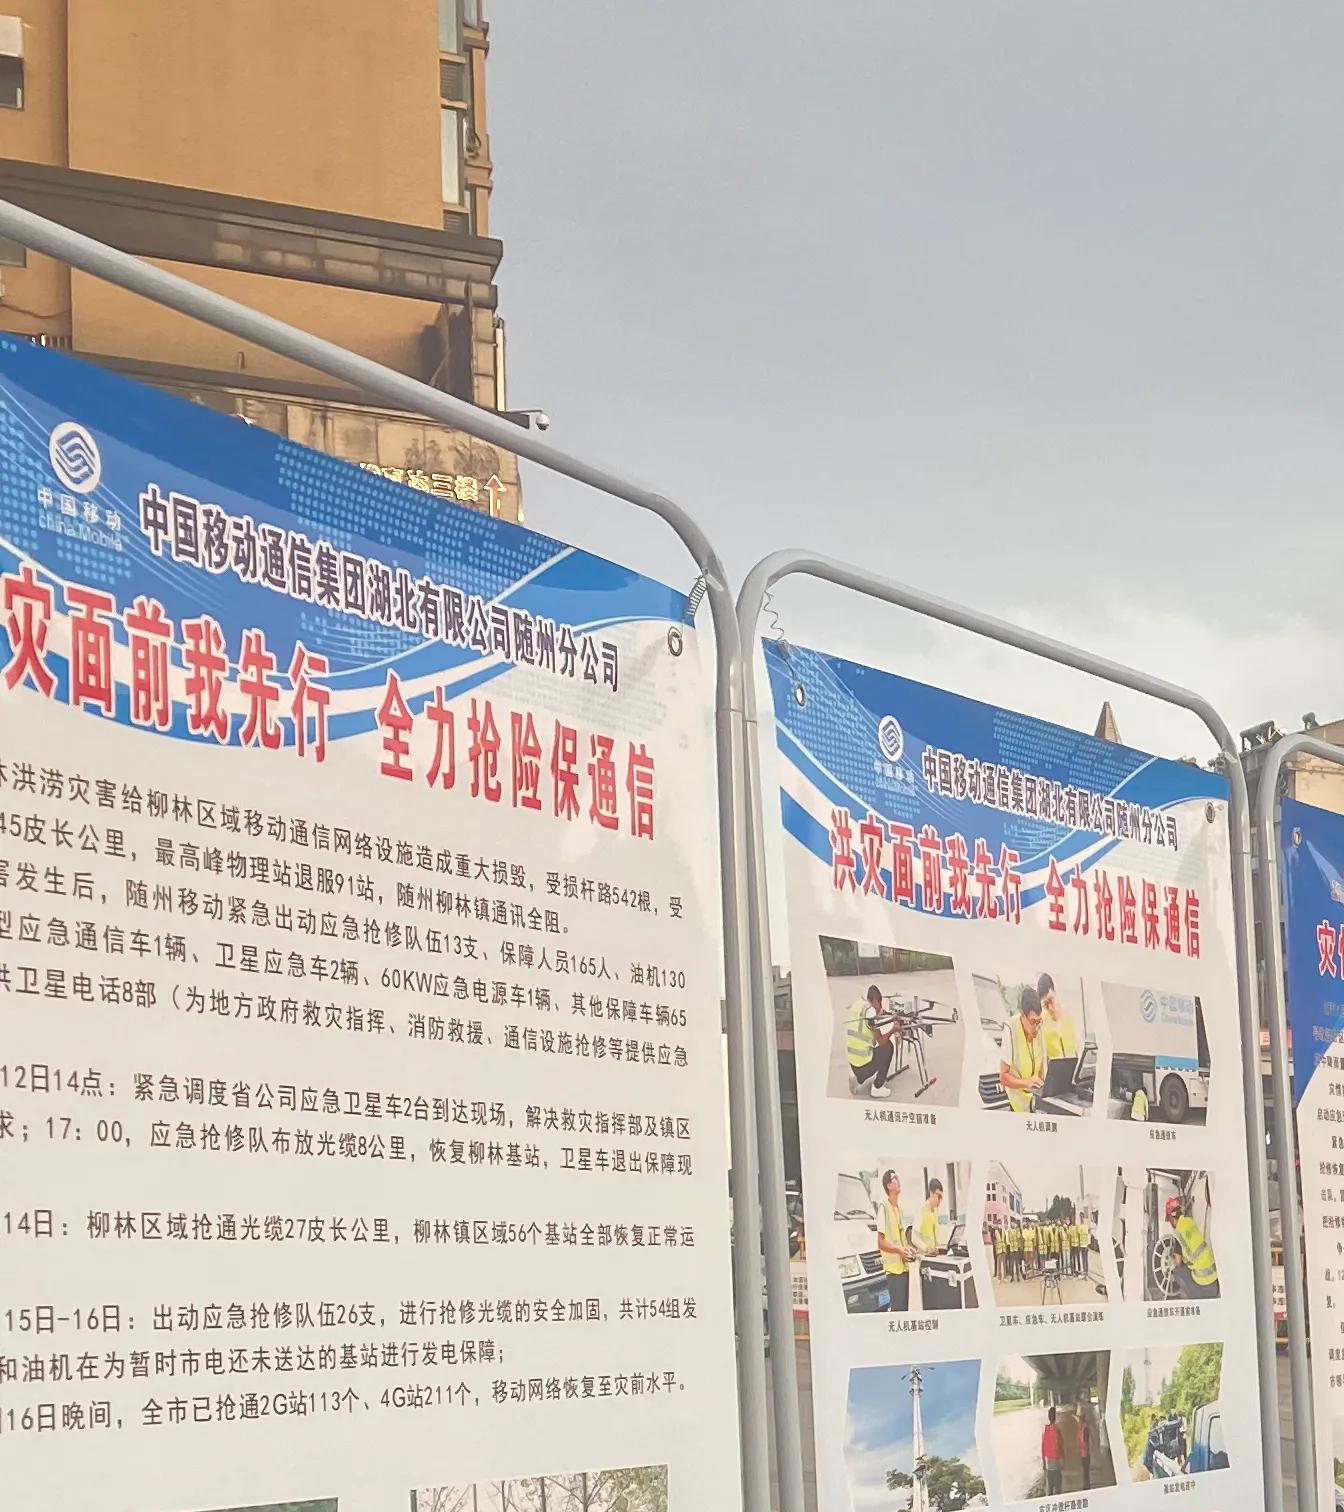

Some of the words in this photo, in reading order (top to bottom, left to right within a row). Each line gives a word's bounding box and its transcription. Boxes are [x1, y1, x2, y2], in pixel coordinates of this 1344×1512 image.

[37, 488, 121, 531] 中国移动
[140, 485, 619, 692] 中国移动通信集团湖北有限公司随州分公司
[2, 566, 331, 763] 灾面前我先行
[377, 671, 654, 840] 全力抢险保通信
[0, 762, 683, 919] 洪涝灾害给柳林区域移动通信网络设施造成重大损毁，受损杆路542根，受
[922, 746, 1178, 851] 中国移动通信集团湖北有限公司随州分公司
[828, 807, 1022, 925] 洪灾面前我先行
[1045, 858, 1201, 958] 全力抢险保通信
[0, 1372, 685, 1433] 16日晚间，全市已抢通2G站113个、4G站211个，移动网络恢复至灾前水平。
